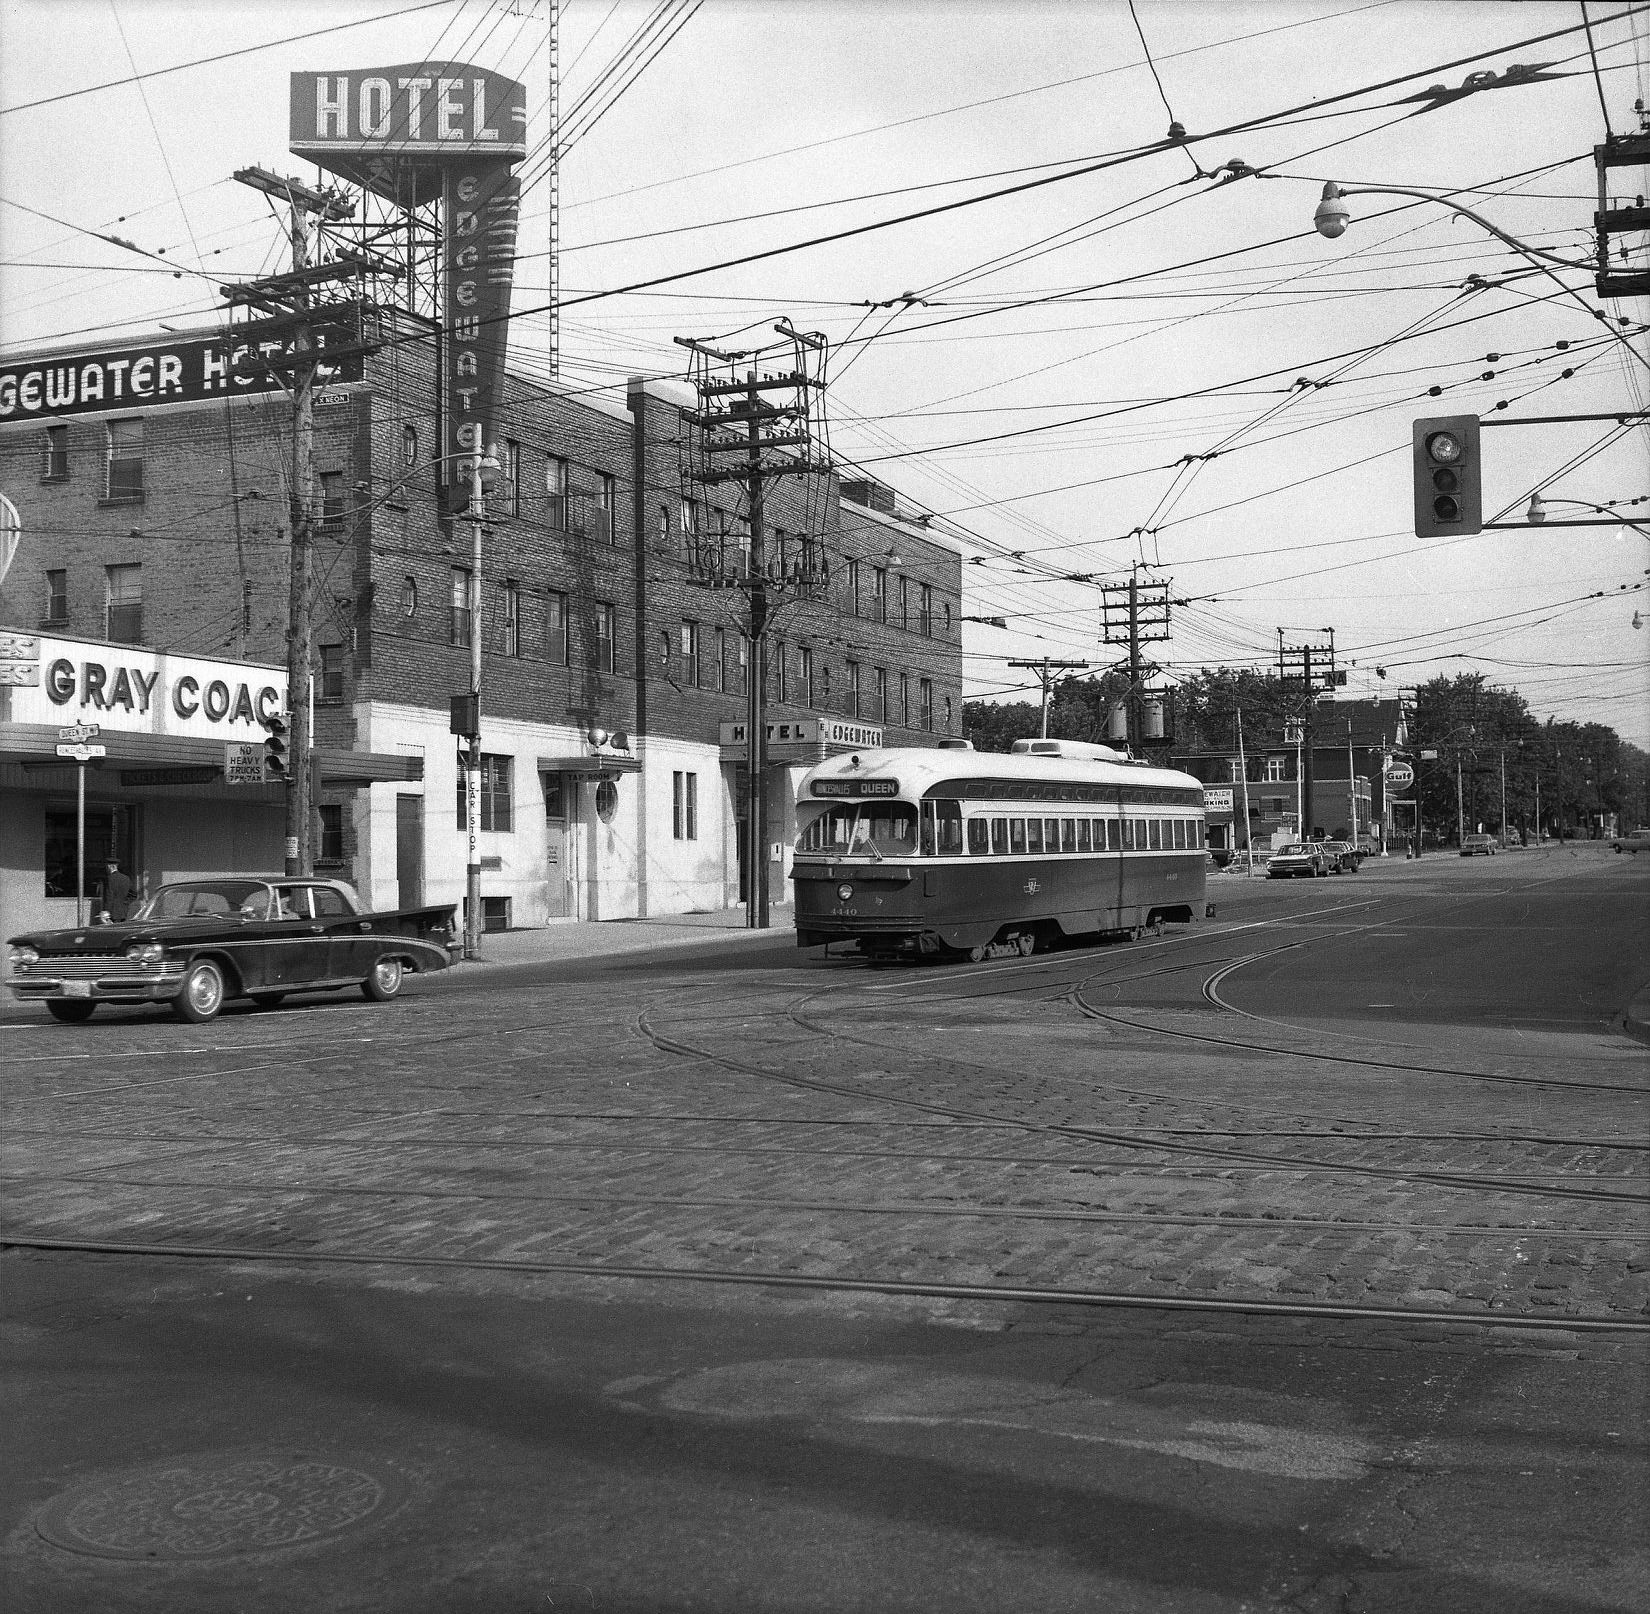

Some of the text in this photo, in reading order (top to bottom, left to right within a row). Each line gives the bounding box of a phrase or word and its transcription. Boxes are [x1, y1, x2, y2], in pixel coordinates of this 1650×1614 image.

[316, 76, 499, 141] HOTEL
[456, 175, 480, 486] EDGEWATER
[0, 353, 183, 416] GEWATER
[45, 658, 289, 733] GRAY COAC
[734, 725, 805, 740] HTEL
[833, 724, 881, 747] EDGEWATER
[240, 746, 252, 755] NO
[230, 756, 260, 765] HEAVY
[230, 766, 261, 774] TRUCKS
[1387, 771, 1412, 780] Gulf
[860, 783, 895, 794] QUEEN
[831, 908, 857, 916] 4440
